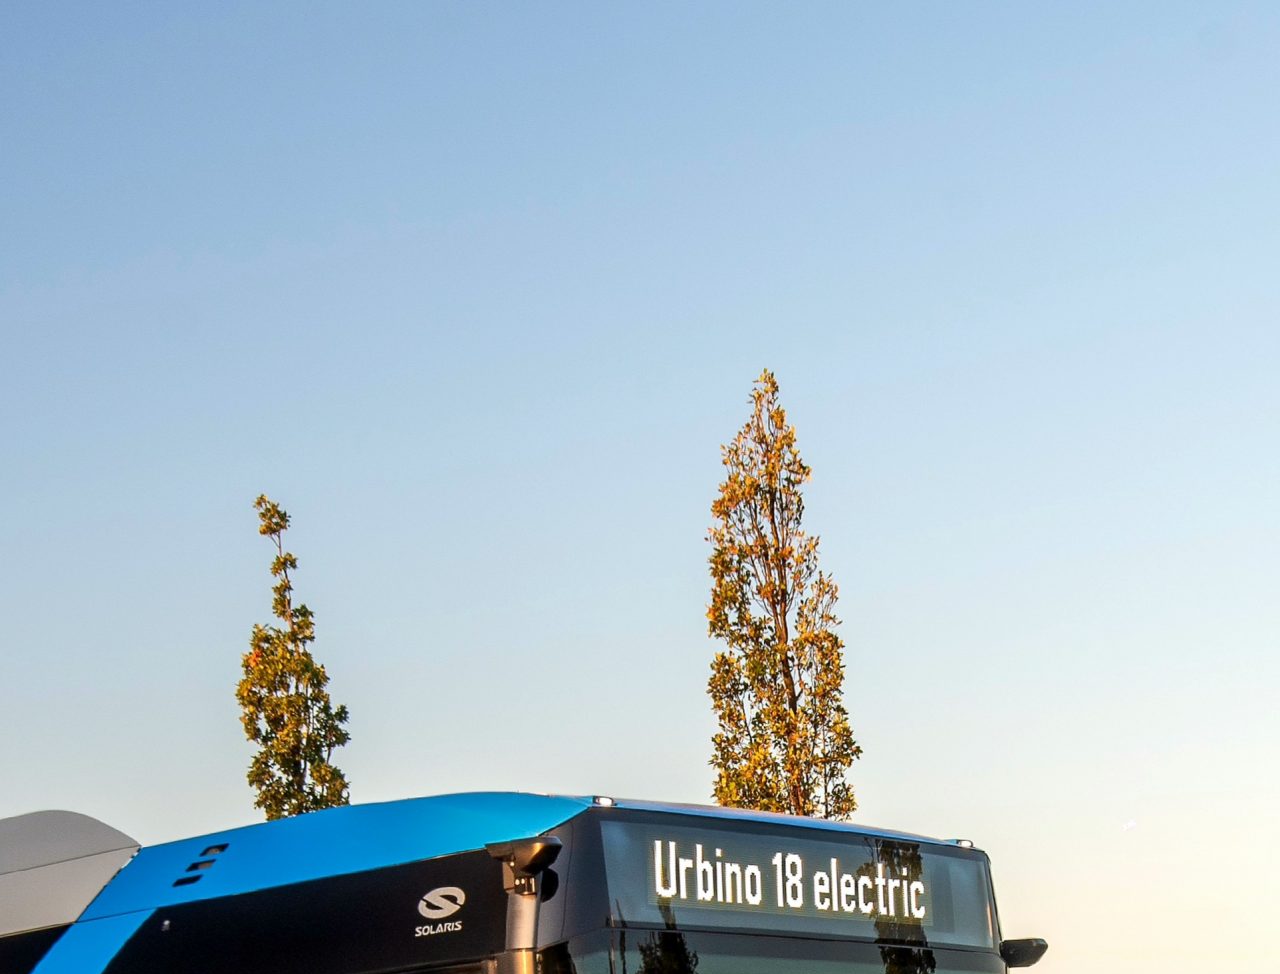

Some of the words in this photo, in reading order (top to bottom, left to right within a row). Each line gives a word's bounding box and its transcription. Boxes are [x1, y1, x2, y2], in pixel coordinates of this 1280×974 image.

[654, 840, 762, 905] Urbino
[772, 852, 804, 908] 18
[813, 857, 926, 919] electric
[414, 920, 463, 937] SOLARIS
